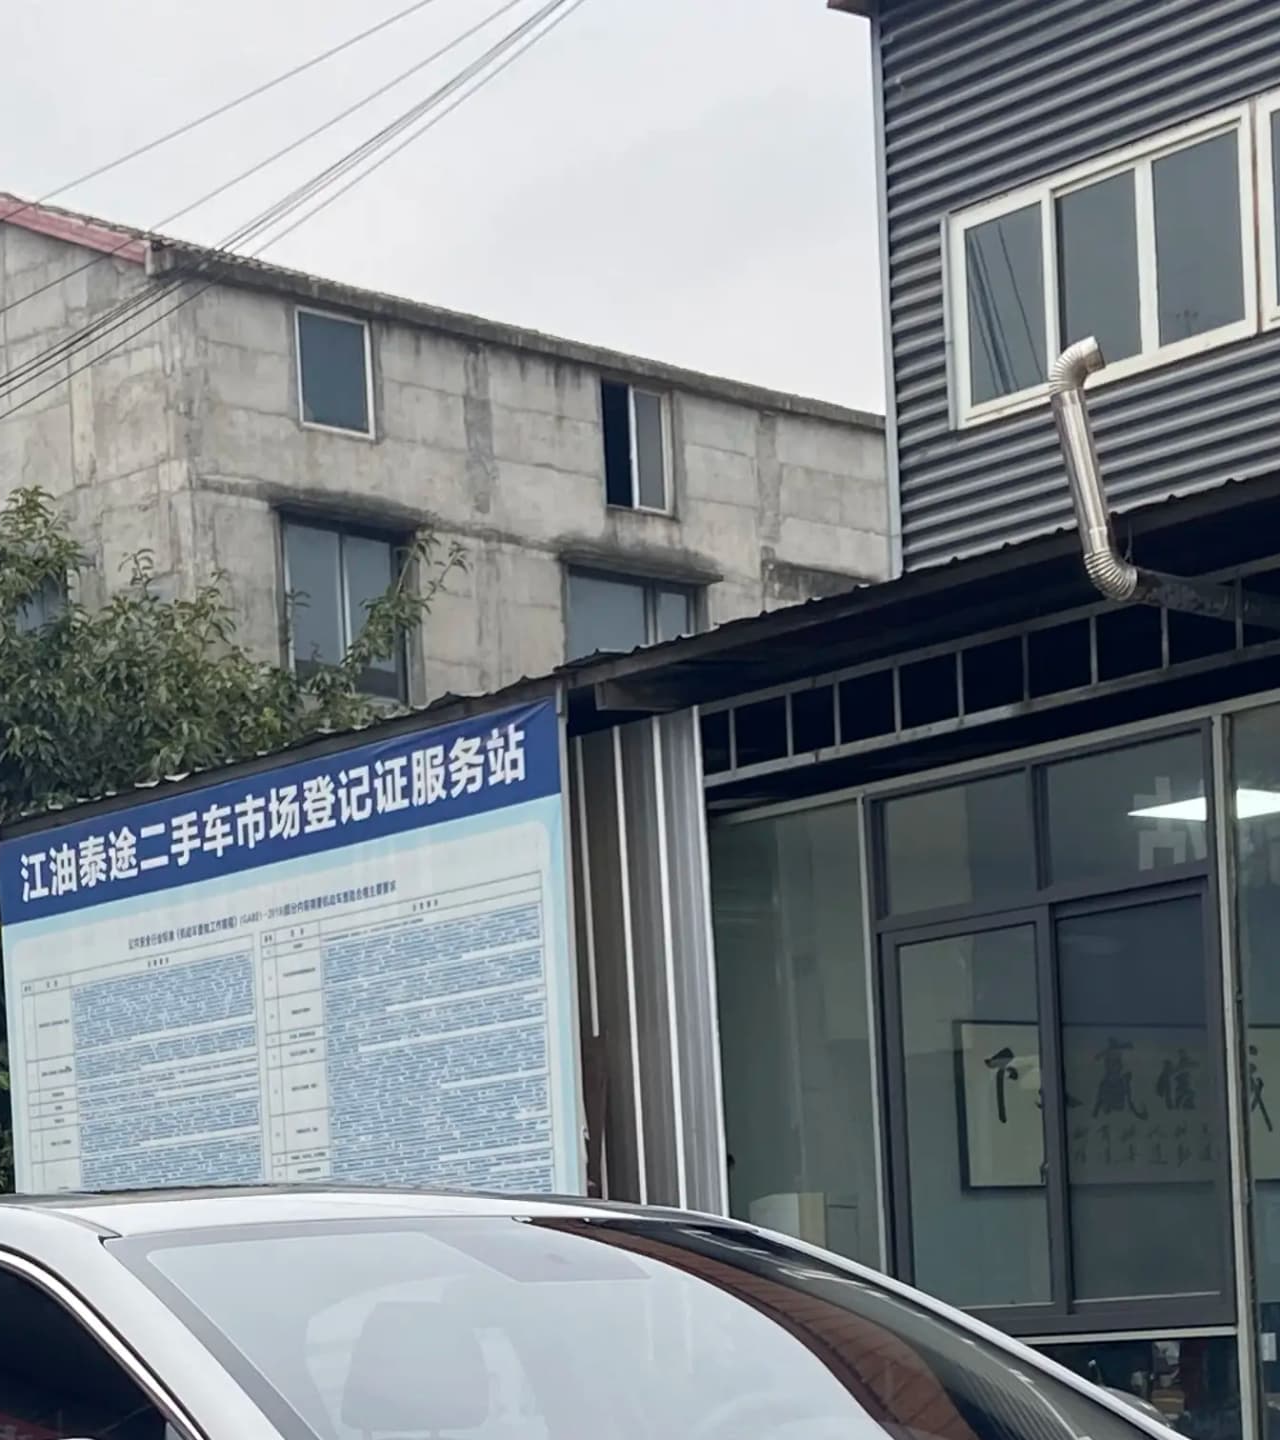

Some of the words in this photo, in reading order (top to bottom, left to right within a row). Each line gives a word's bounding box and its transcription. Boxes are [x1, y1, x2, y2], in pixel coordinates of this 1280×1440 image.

[20, 724, 527, 903] 江油泰途二手车市场登记证服务站
